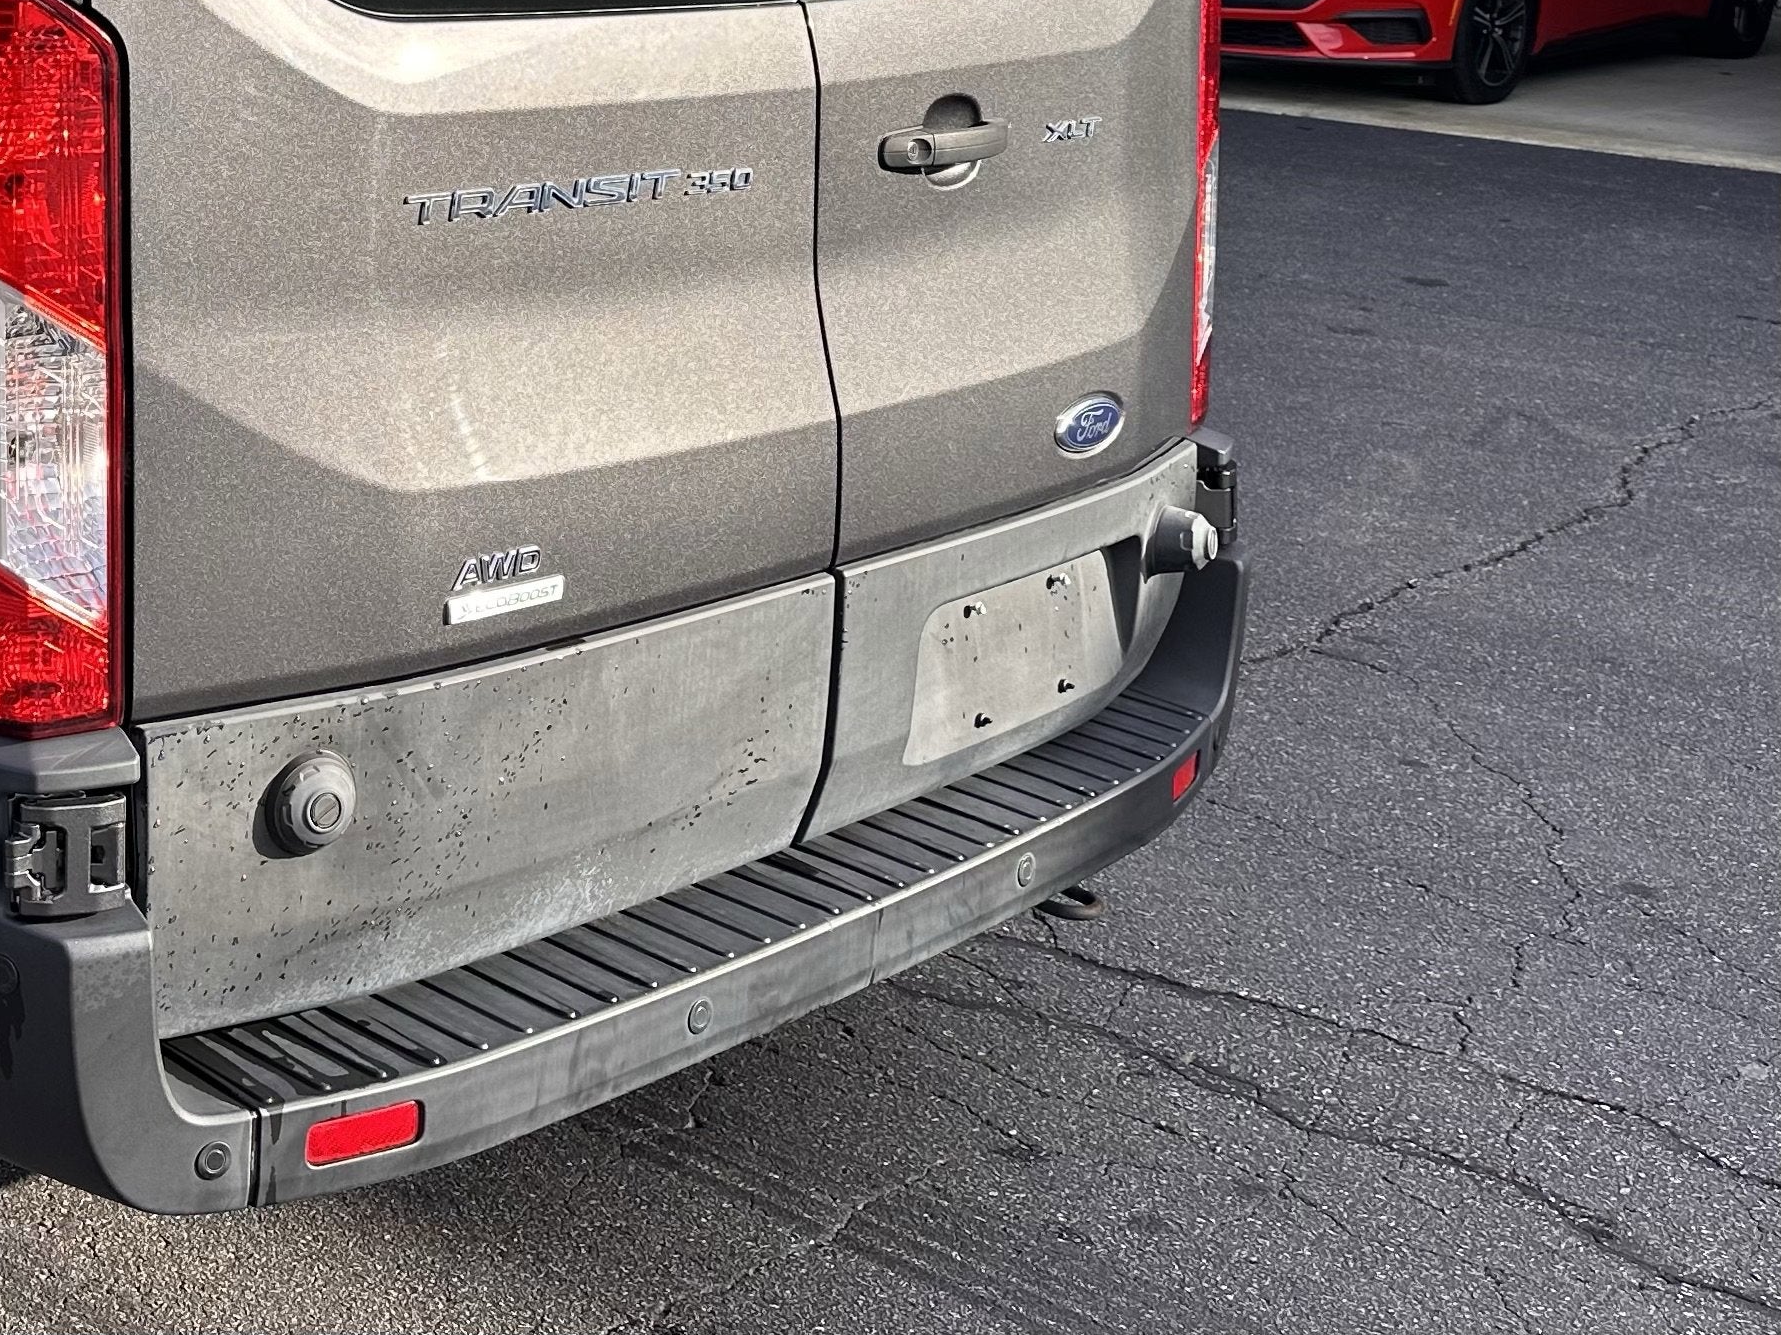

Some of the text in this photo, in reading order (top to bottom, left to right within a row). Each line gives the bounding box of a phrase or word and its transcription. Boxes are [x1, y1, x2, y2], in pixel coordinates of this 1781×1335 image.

[1042, 116, 1103, 143] XLT
[403, 167, 755, 226] TRANSIT 350
[1076, 408, 1113, 442] Ford
[450, 544, 541, 592] AWD
